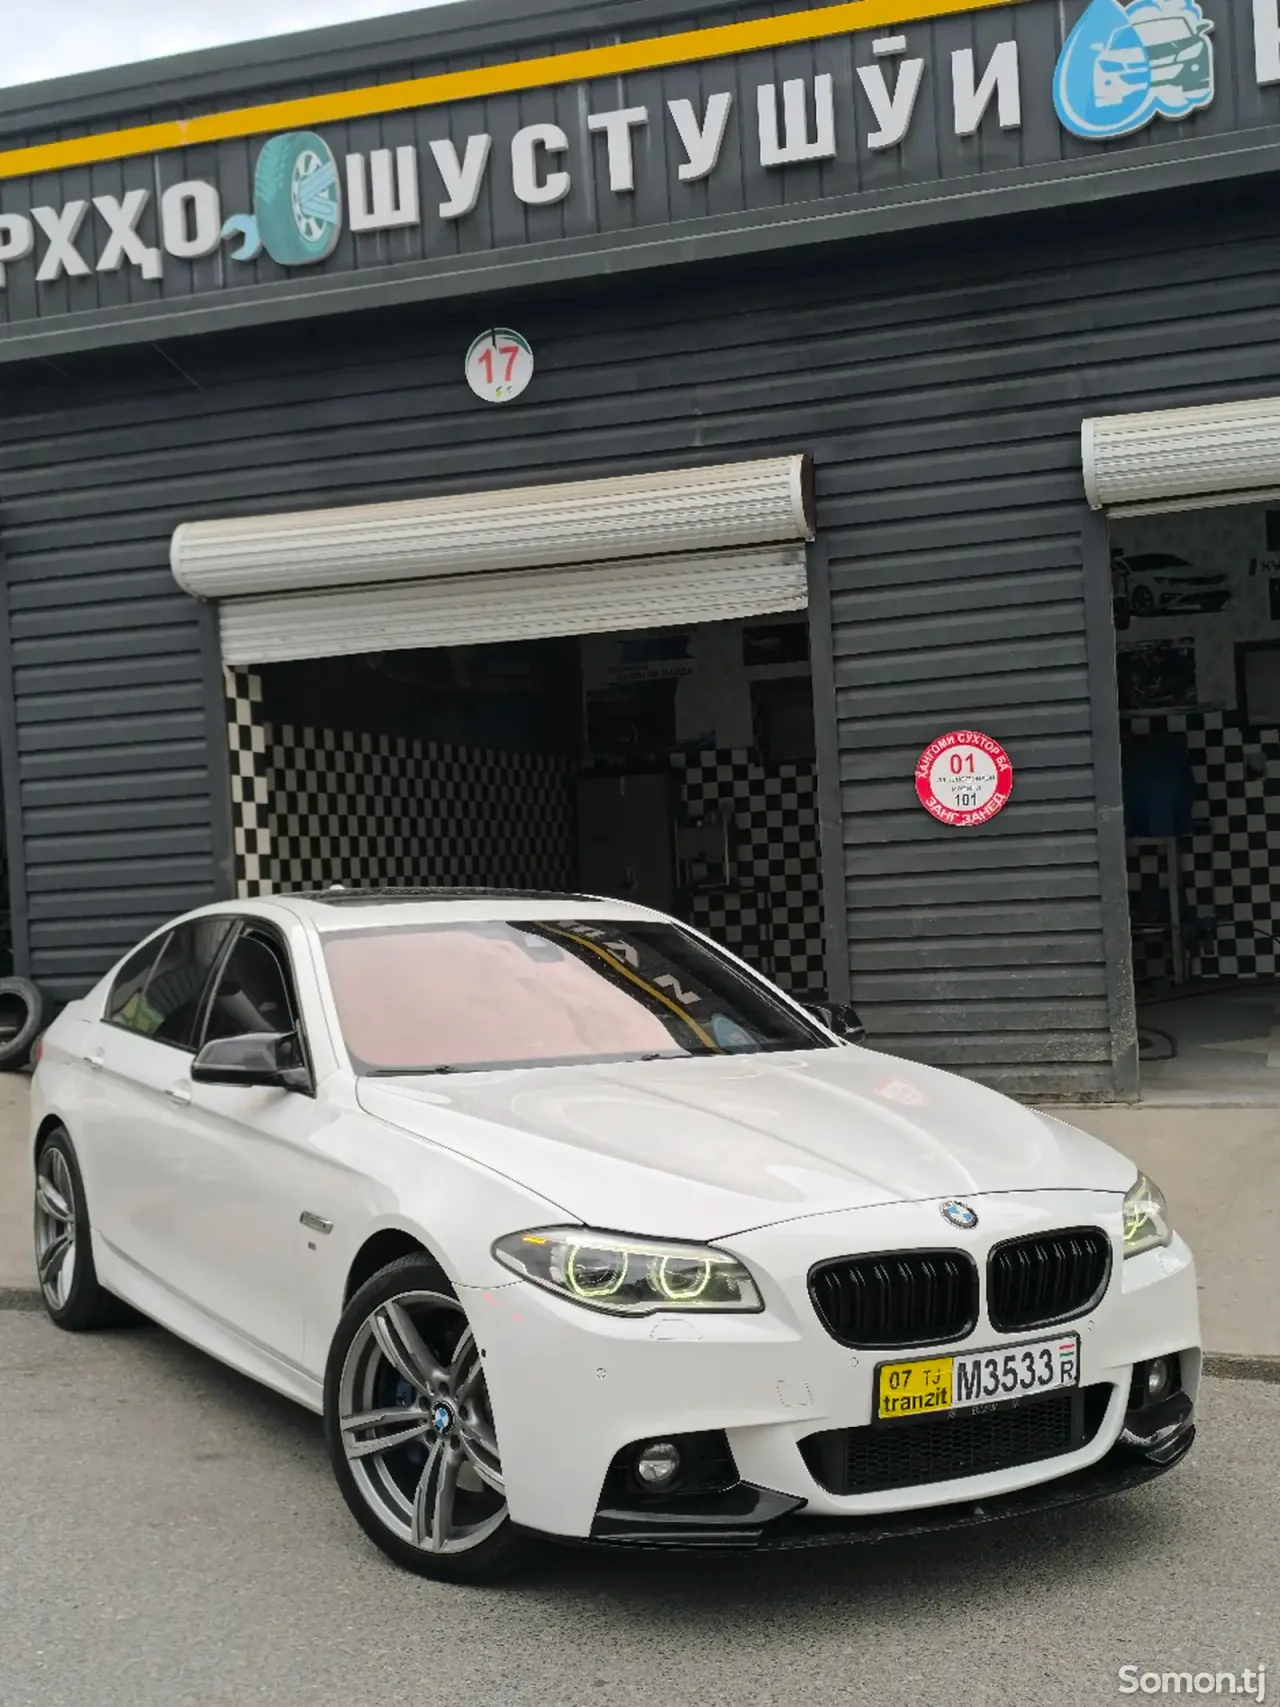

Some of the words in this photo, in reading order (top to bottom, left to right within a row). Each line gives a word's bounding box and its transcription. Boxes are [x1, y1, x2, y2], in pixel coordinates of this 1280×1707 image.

[477, 345, 520, 384] 17
[950, 753, 975, 774] 01
[954, 793, 977, 806] 101
[889, 1370, 912, 1390] 07
[923, 1368, 942, 1386] TJ
[956, 1349, 1053, 1401] M3533
[1060, 1360, 1075, 1384] R
[883, 1387, 948, 1412] tranzit
